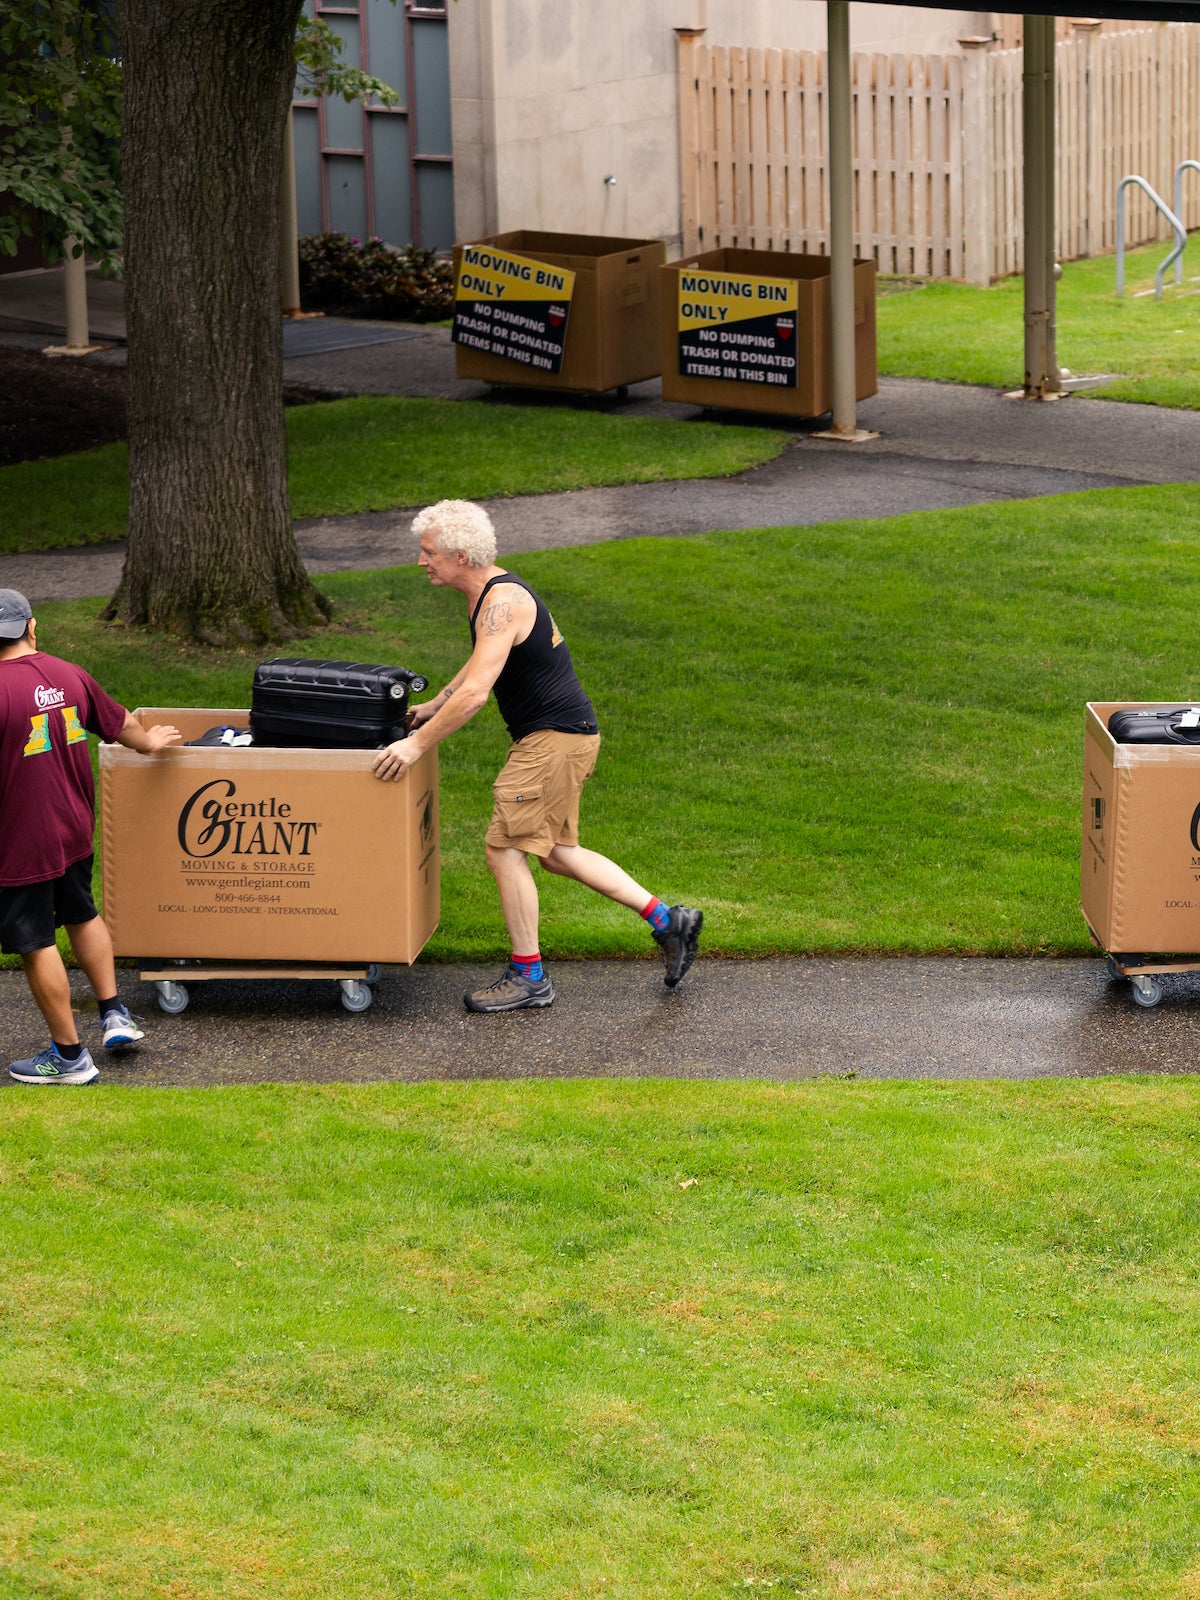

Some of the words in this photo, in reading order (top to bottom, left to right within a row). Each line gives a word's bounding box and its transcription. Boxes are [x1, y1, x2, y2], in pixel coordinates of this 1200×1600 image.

[464, 249, 532, 281] MOVING
[535, 269, 564, 291] BIN
[461, 274, 505, 298] ONLY
[681, 276, 752, 298] MOVING
[757, 284, 787, 302] BIN
[474, 302, 492, 316] NO
[494, 308, 546, 333] DUMPING
[681, 303, 728, 321] ONLY
[456, 314, 491, 334] TRASH
[493, 326, 508, 339] OR
[510, 331, 562, 355] DONATED
[699, 329, 718, 342] NO
[720, 331, 776, 349] DUMPING
[458, 331, 491, 350] ITEMS
[492, 341, 505, 355] IN
[507, 346, 531, 363] THIS
[532, 354, 552, 370] BIN
[682, 345, 719, 359] TRASH
[721, 349, 739, 361] OR
[740, 351, 796, 368] DONATED
[687, 363, 722, 377] ITEMS
[723, 366, 737, 378] IN
[739, 368, 765, 382] THIS
[767, 371, 788, 385] BIN
[178, 779, 317, 858] GIANT
[181, 860, 236, 870] MOVING
[241, 863, 248, 871] &
[253, 861, 315, 872] STORAGE
[186, 877, 310, 890] www.gentlegiant.com
[215, 893, 281, 903] 800-466-8844
[1165, 900, 1193, 908] LOCAL
[158, 904, 187, 913] LOCAL
[193, 905, 217, 914] LONG
[218, 905, 262, 914] DISTANCE
[268, 906, 339, 916] INTERNATIONAL
